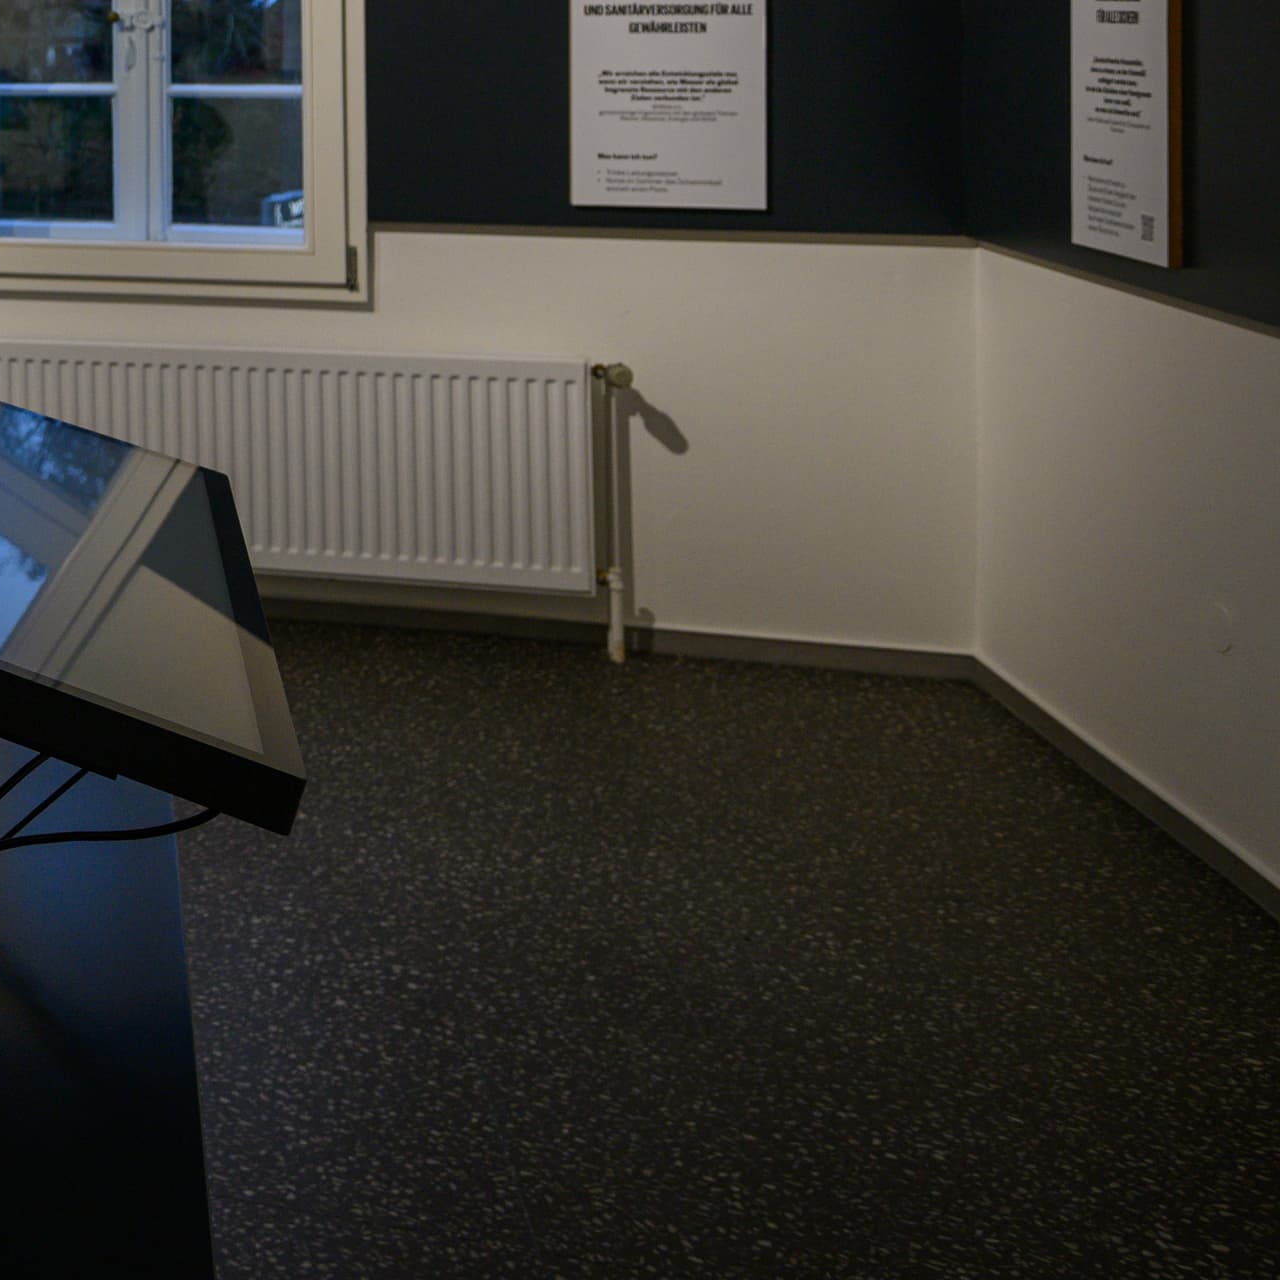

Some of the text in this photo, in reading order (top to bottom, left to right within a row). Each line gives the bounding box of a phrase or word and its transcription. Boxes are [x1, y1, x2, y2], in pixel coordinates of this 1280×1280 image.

[584, 4, 603, 16] UND
[710, 2, 730, 16] FÜR
[731, 3, 754, 16] ALLE
